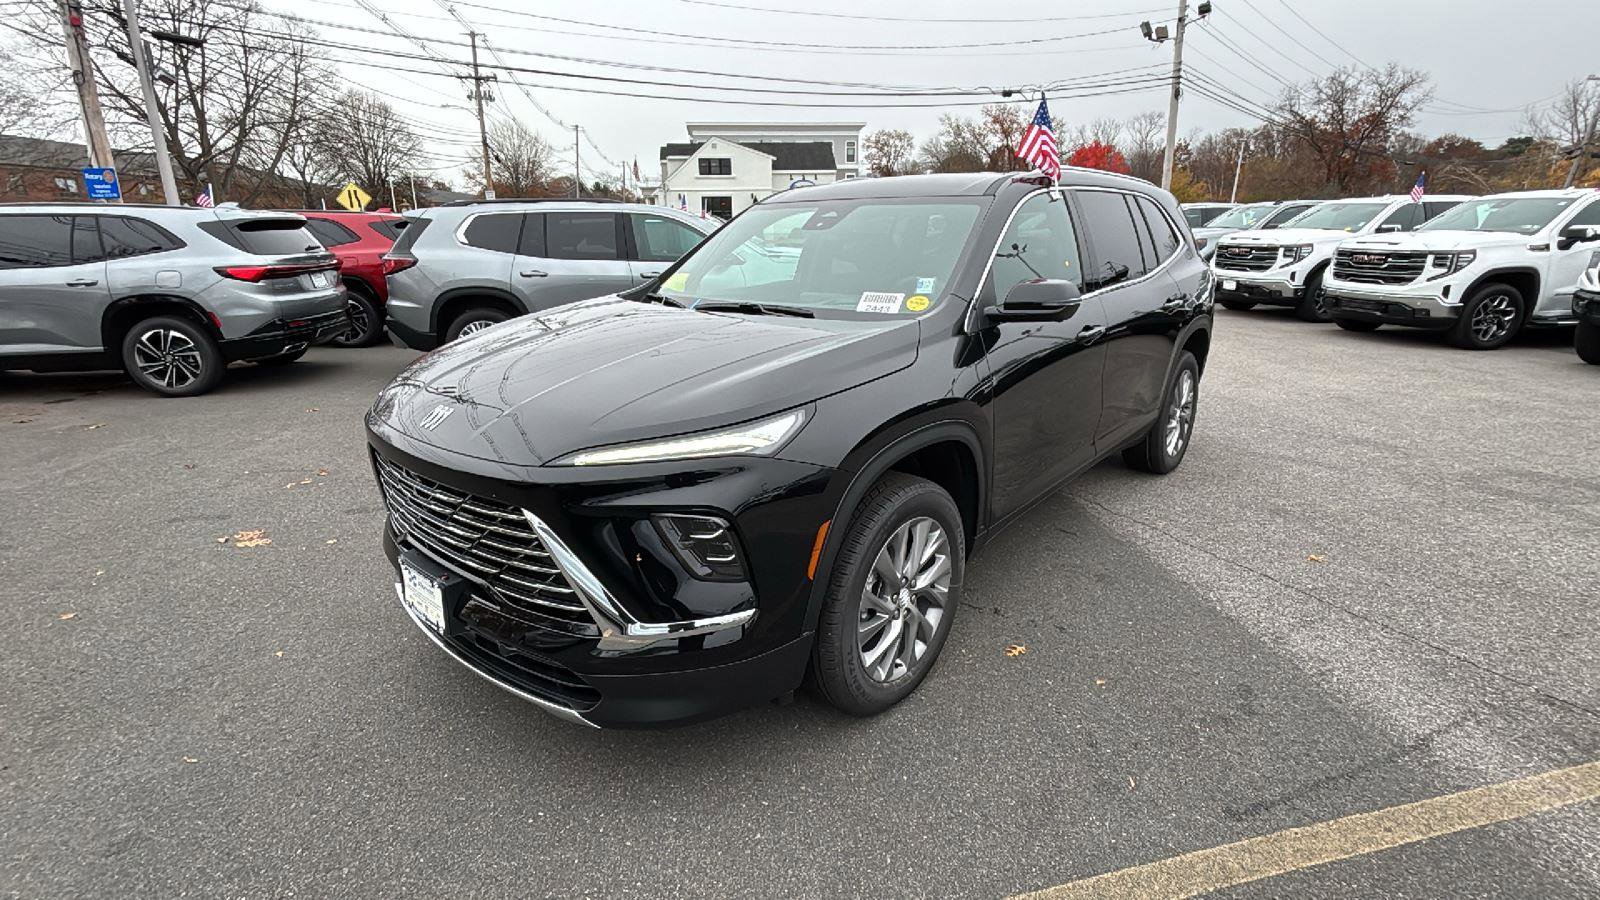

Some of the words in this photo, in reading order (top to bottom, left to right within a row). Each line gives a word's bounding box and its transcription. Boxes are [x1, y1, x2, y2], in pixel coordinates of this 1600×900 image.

[84, 173, 103, 181] Rotary
[1228, 247, 1250, 255] GMC
[1353, 254, 1386, 263] GMC
[865, 304, 891, 312] 2443
